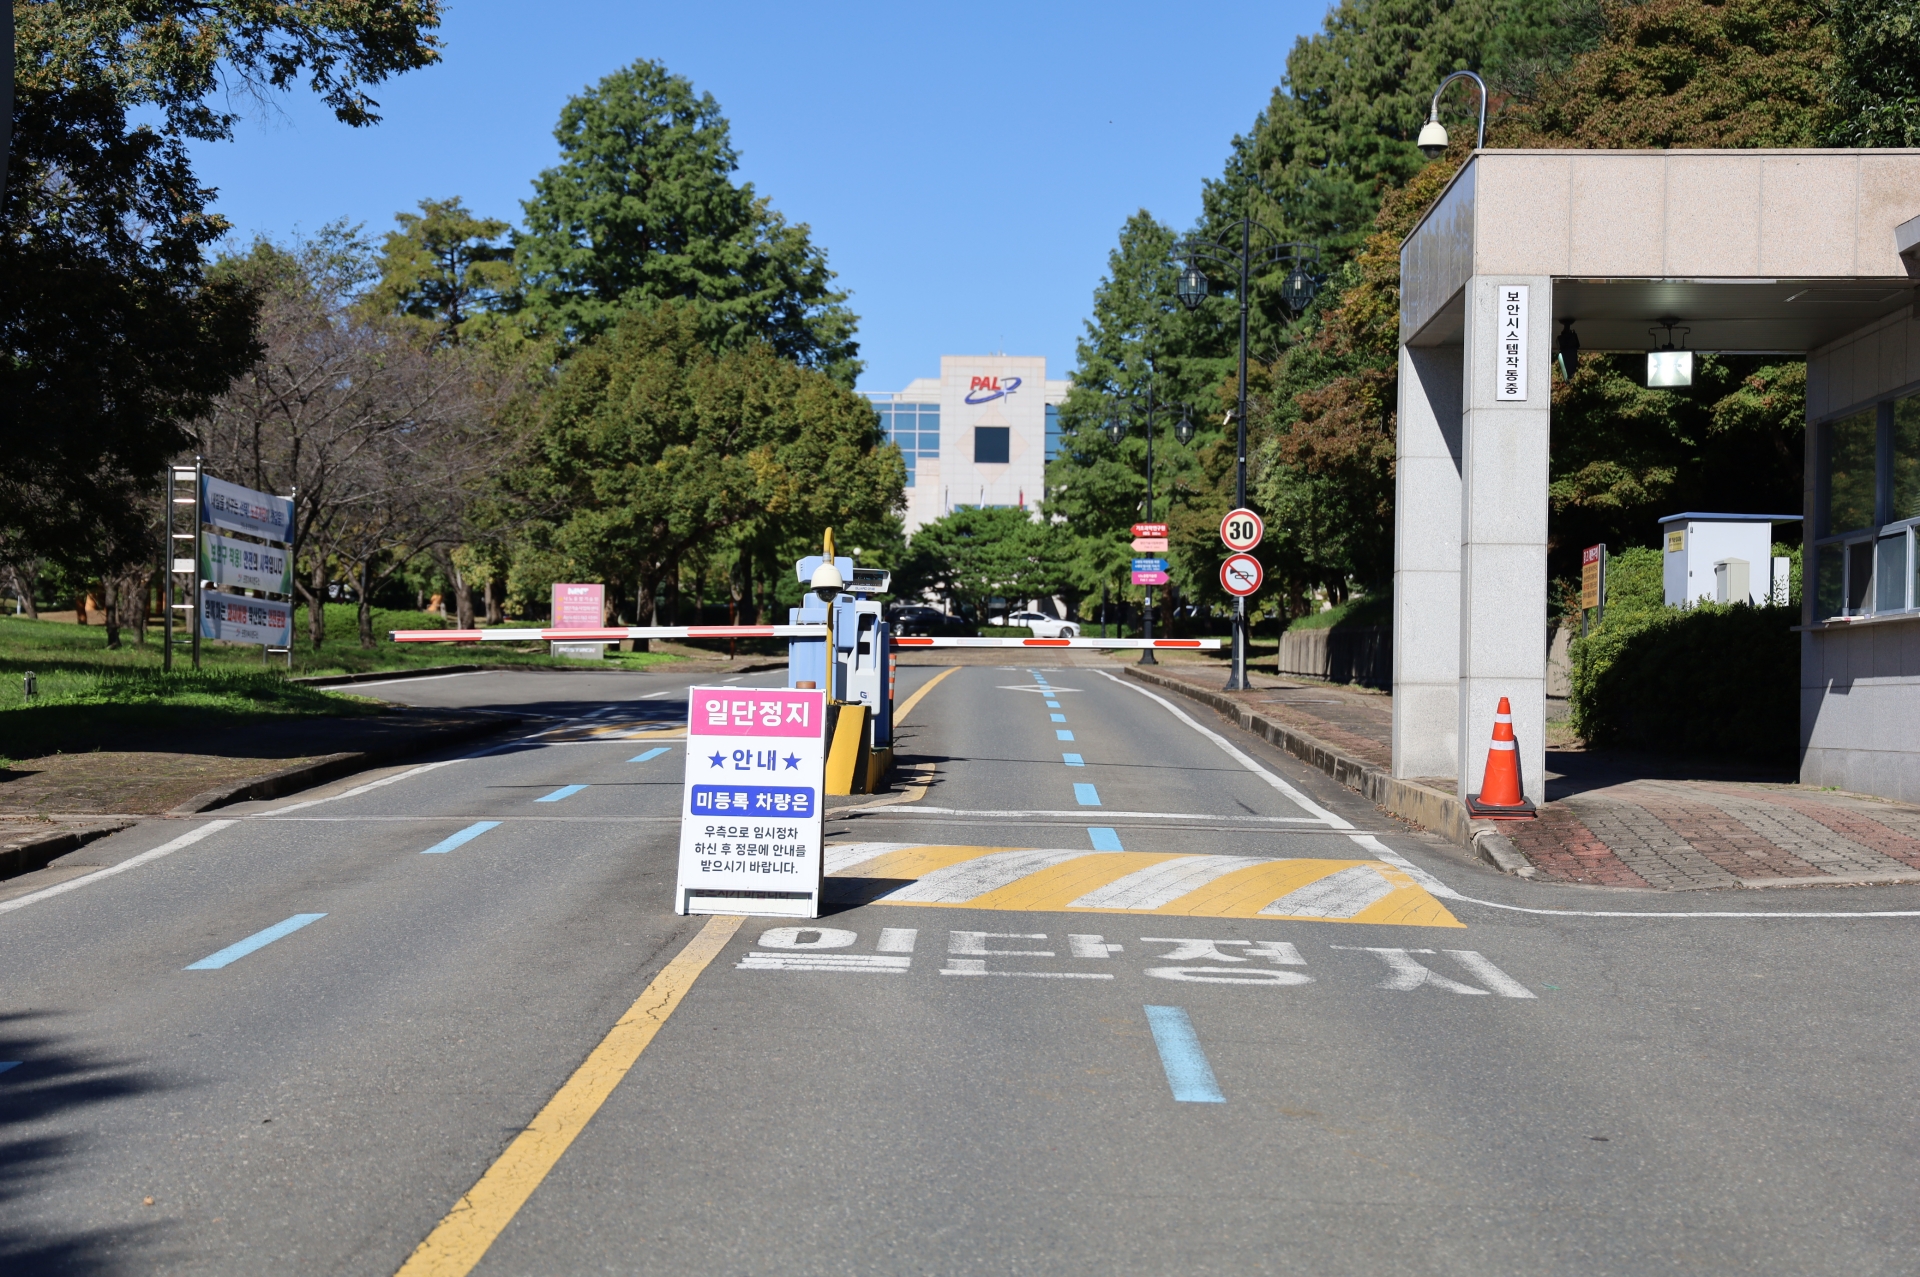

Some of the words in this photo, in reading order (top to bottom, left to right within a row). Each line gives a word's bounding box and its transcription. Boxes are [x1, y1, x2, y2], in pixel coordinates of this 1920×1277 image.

[1505, 291, 1520, 394] 보안시스템작동중
[970, 376, 1001, 391] PAL
[1229, 521, 1254, 540] 30
[211, 543, 227, 566] 보호구
[229, 547, 242, 568] 착용!
[243, 550, 258, 571] 안전의
[260, 554, 283, 575] 시작입니다
[205, 599, 226, 621] 함께하는
[705, 699, 810, 727] 일단정지
[732, 749, 777, 771] 안내
[697, 792, 749, 810] 미등록
[756, 793, 809, 811] 차량은
[704, 826, 750, 838] 우측으로
[753, 827, 798, 840] 임시정차
[695, 842, 717, 855] 하신
[720, 843, 732, 856] 후
[735, 843, 769, 856] 정문에
[772, 844, 807, 857] 안내를
[701, 860, 746, 873] 받으시기
[750, 861, 799, 874] 바랍니다.
[734, 927, 1539, 999] 일단정지
